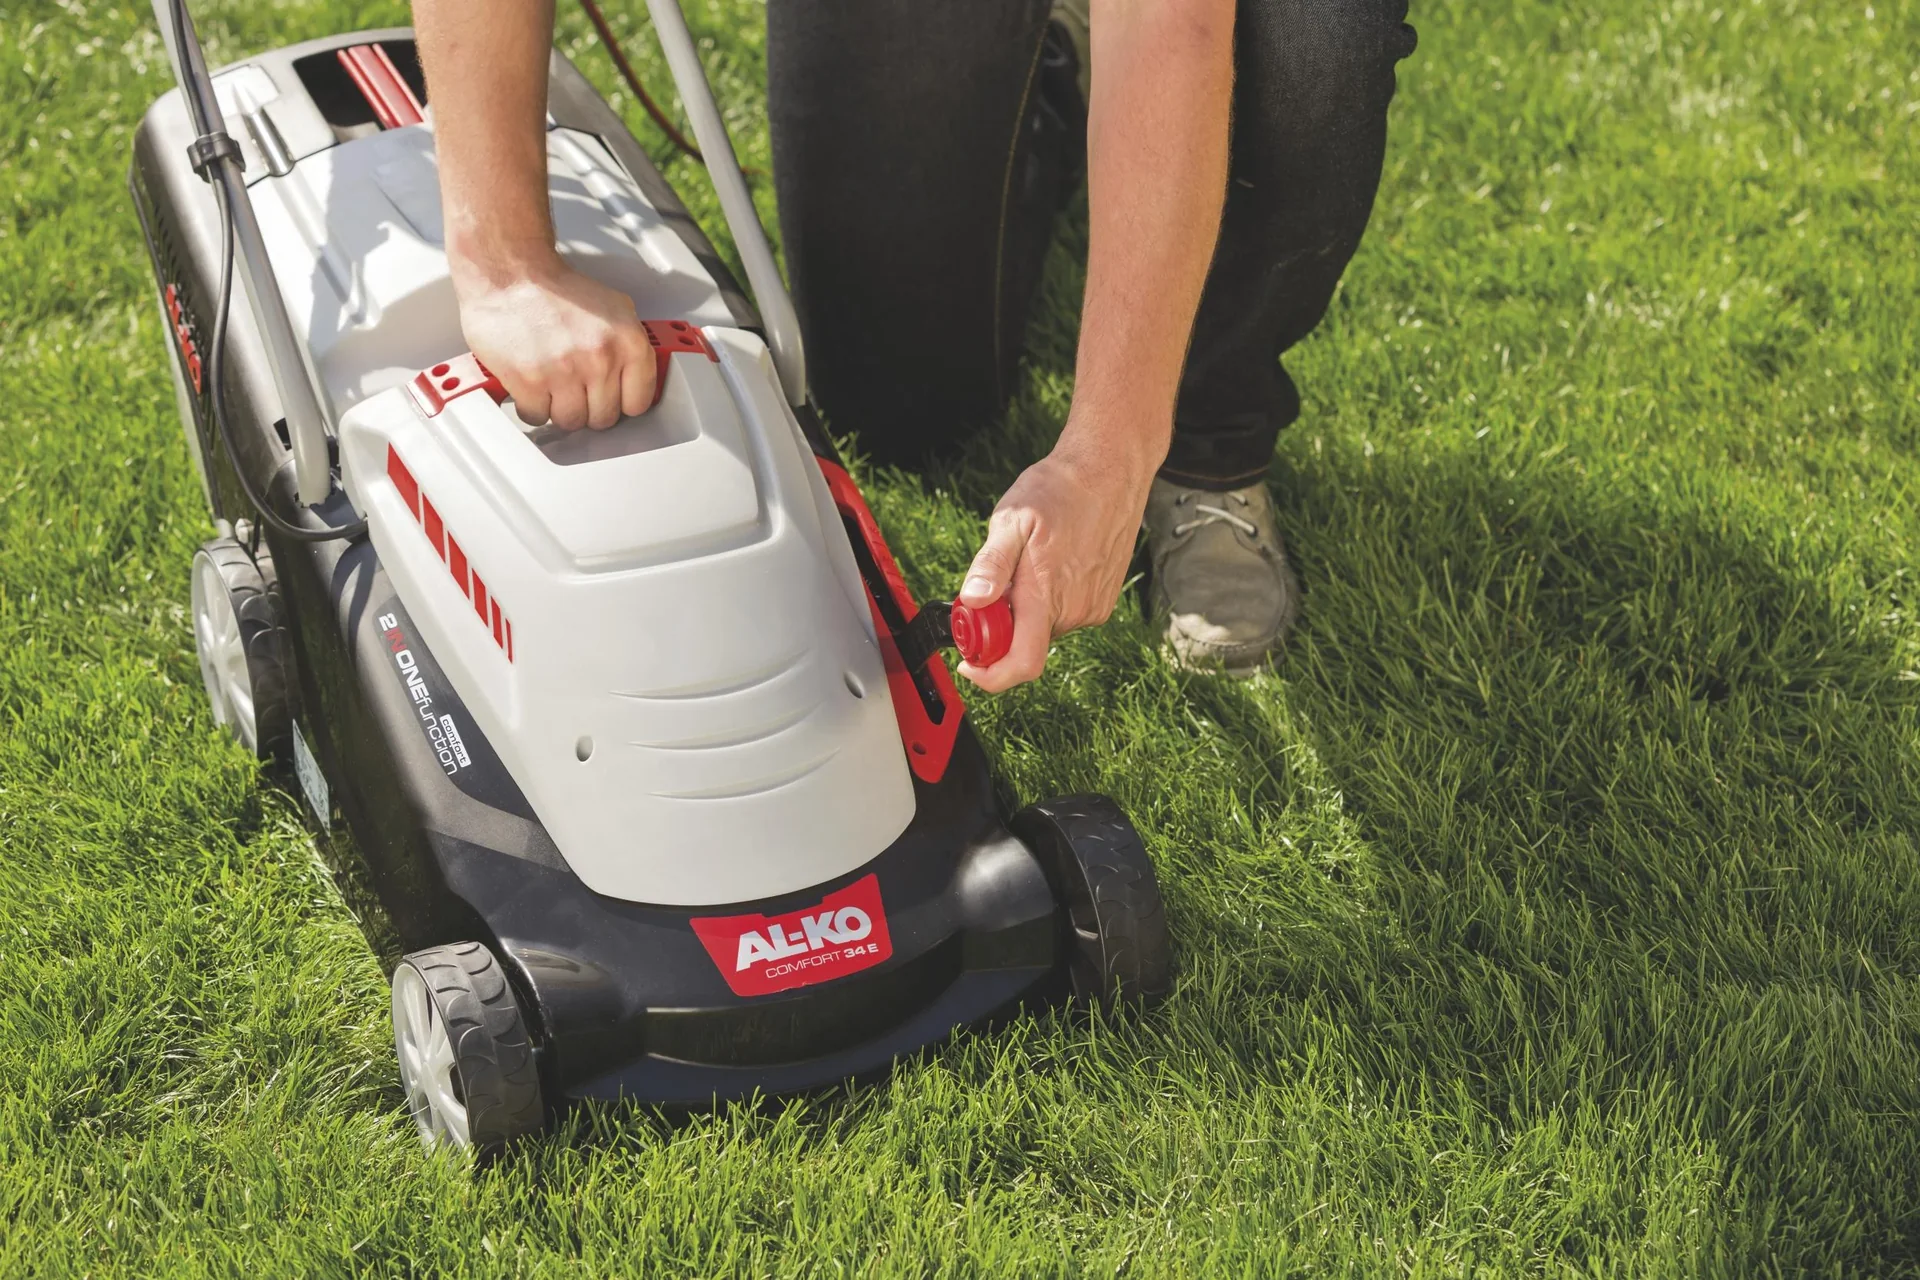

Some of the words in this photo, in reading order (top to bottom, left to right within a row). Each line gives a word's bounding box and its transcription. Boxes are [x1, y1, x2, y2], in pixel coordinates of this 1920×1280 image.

[442, 718, 468, 764] comfort
[736, 906, 872, 972] AL-KO
[765, 951, 841, 979] COMFORT
